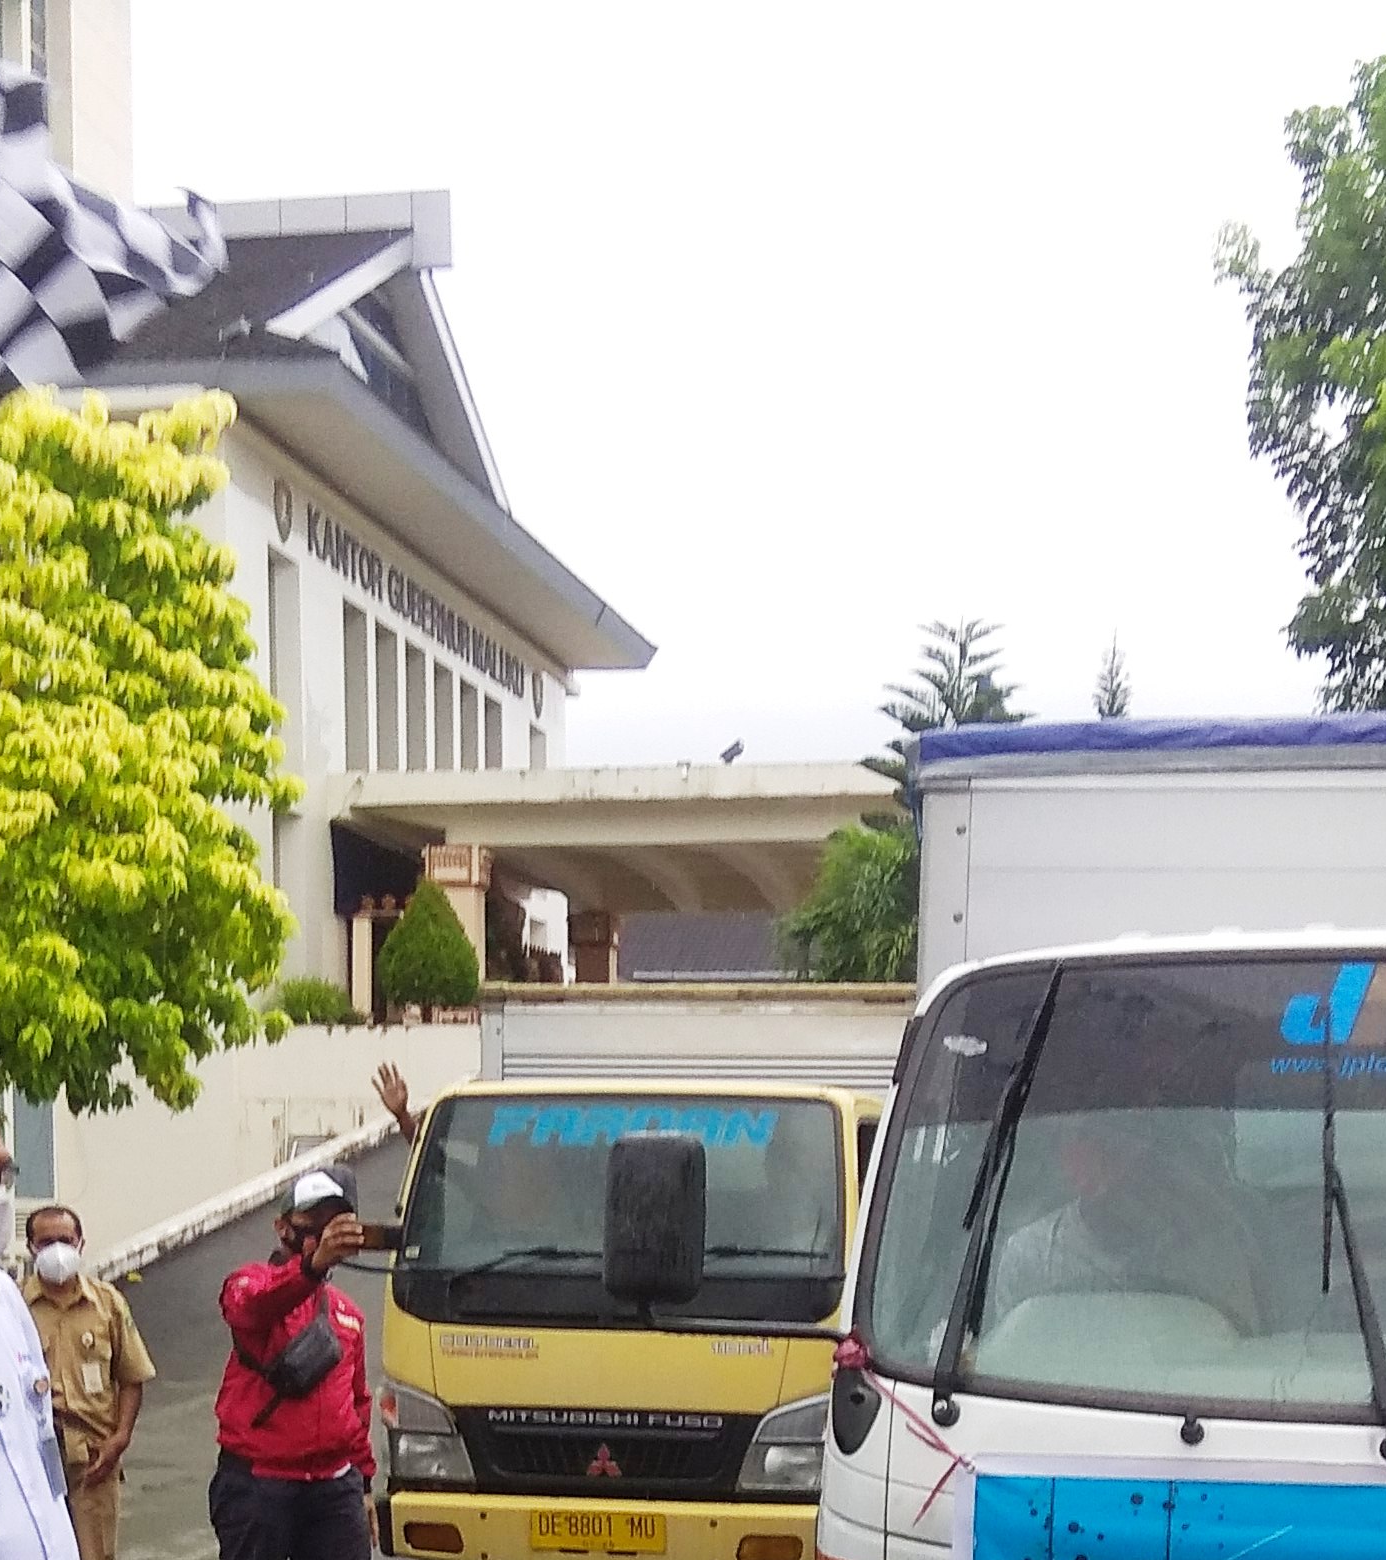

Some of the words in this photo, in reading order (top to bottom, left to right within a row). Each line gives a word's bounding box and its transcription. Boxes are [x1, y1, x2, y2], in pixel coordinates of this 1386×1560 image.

[307, 501, 383, 601] KANTOR
[488, 1409, 639, 1427] MITSUBISHI
[648, 1414, 723, 1429] FUSO
[539, 1511, 562, 1537] DE
[568, 1512, 612, 1538] 8801
[630, 1515, 656, 1539] MU
